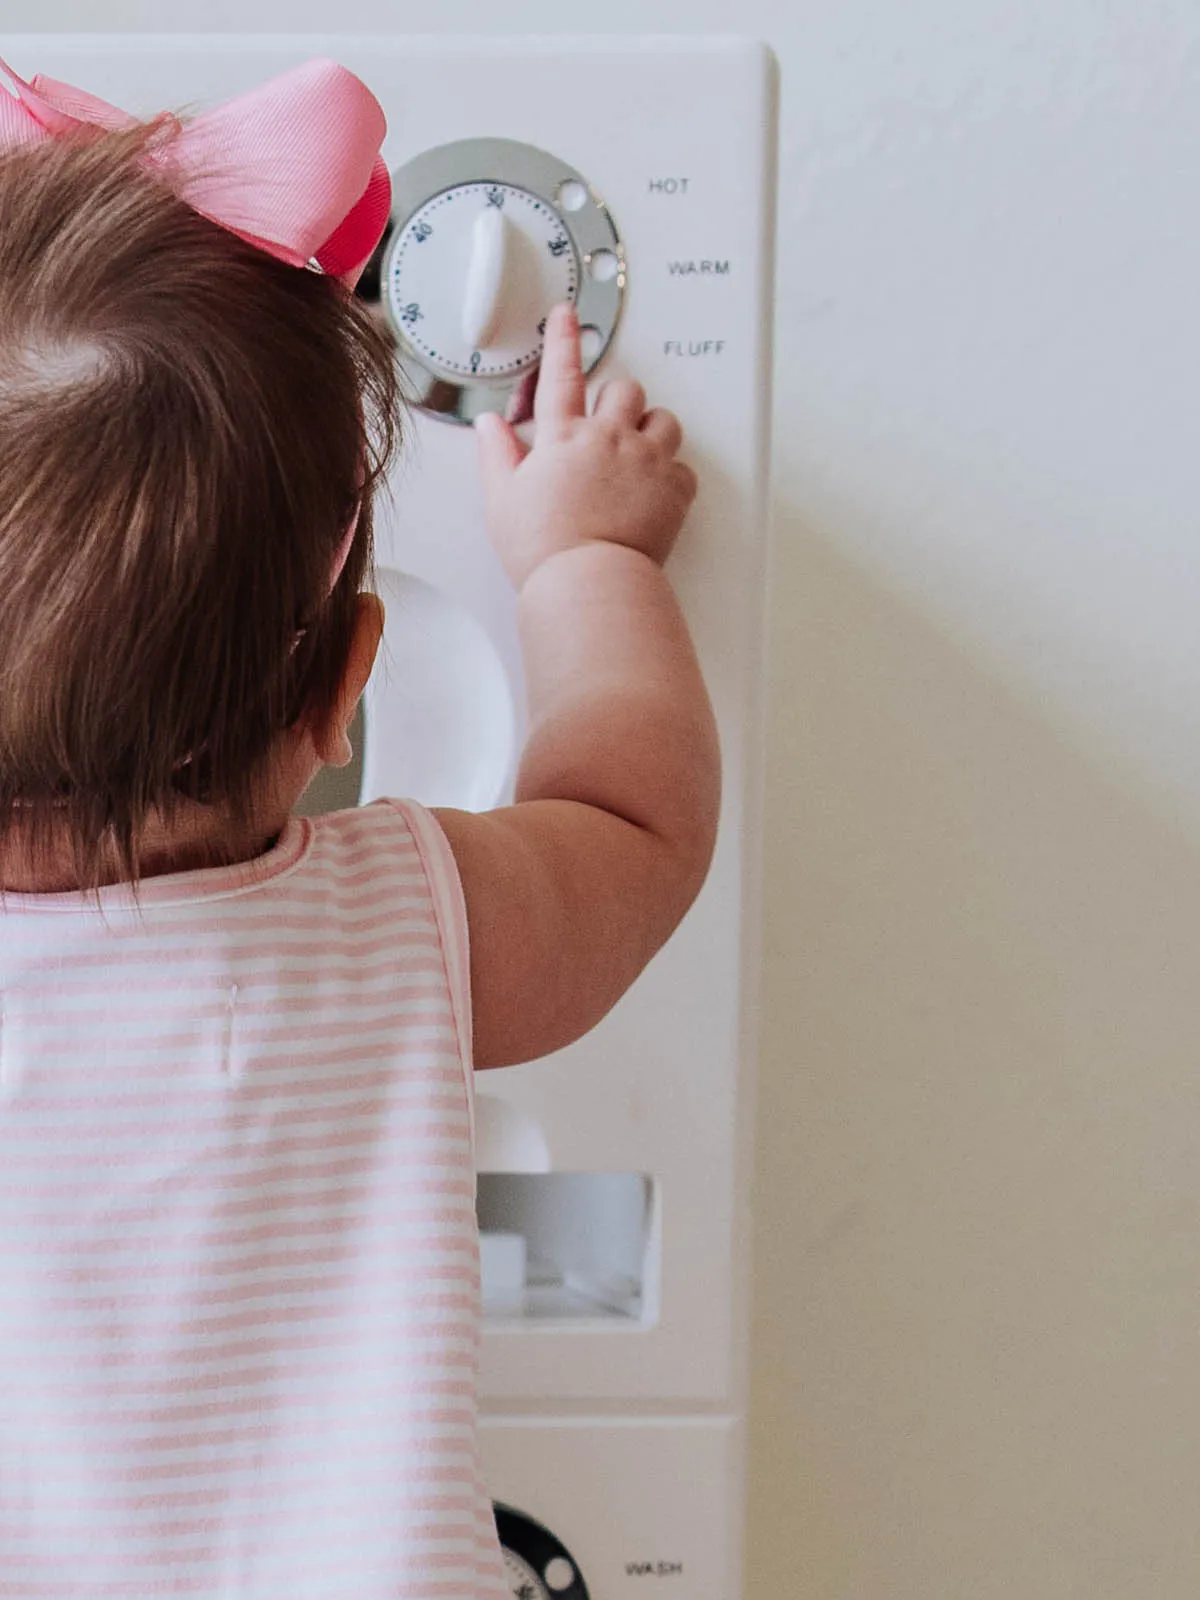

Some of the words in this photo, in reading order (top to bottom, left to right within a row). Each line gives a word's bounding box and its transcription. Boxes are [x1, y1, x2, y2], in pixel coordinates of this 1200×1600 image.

[649, 177, 691, 195] HOT
[668, 260, 730, 276] WARM
[663, 339, 726, 356] FLUFF
[625, 1560, 683, 1577] WASH
